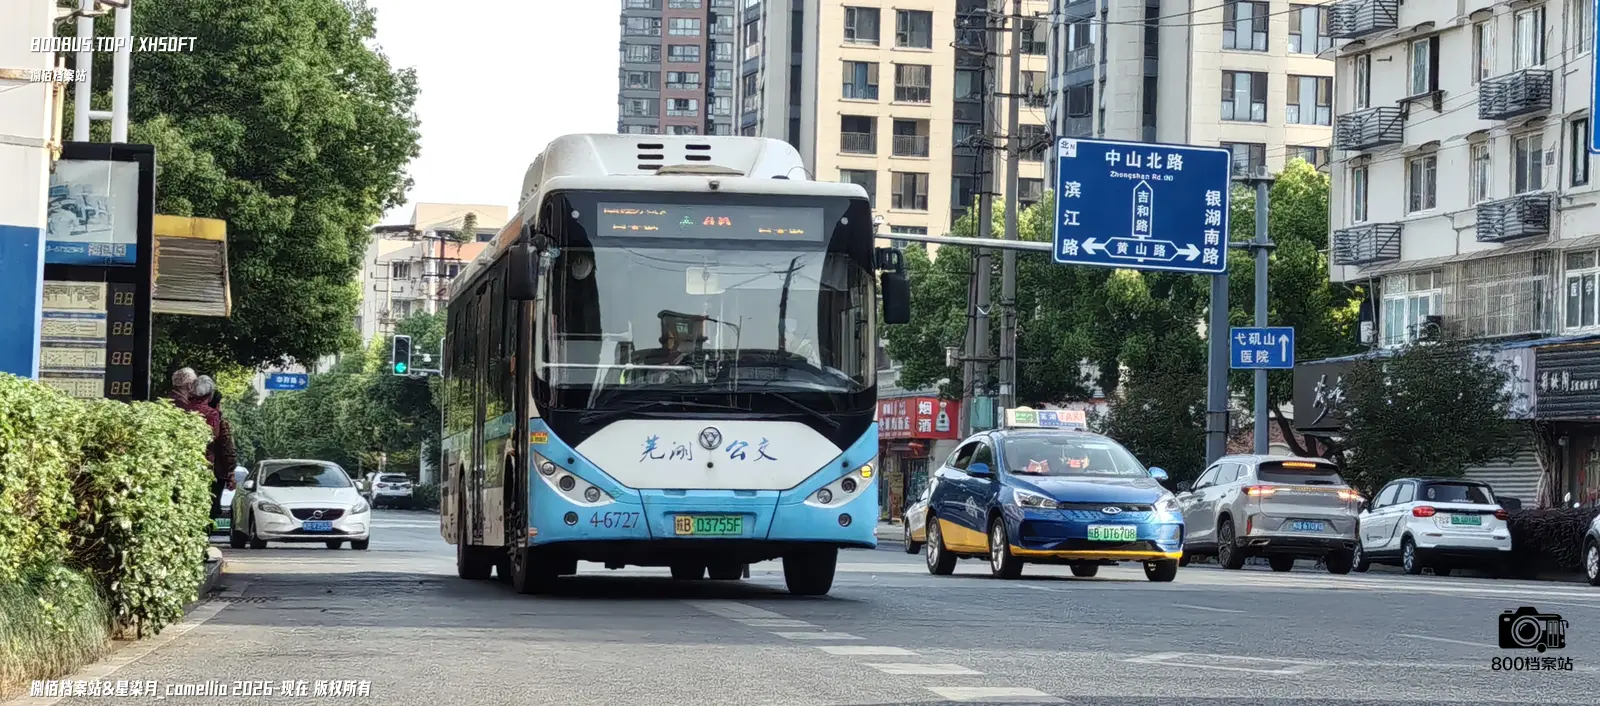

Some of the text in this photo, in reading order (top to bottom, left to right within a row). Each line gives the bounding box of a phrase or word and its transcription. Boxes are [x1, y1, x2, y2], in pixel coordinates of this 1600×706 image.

[1060, 140, 1070, 150] 北
[1105, 149, 1184, 171] 中山北路
[1110, 170, 1150, 180] Zhongshan
[1062, 181, 1081, 256] 滨江路
[1135, 190, 1150, 233] 吉和路
[1202, 189, 1221, 265] 银湖南路
[1116, 241, 1166, 257] 黄山路
[1234, 332, 1275, 346] 弋矶山
[1240, 350, 1270, 363] 医院
[919, 401, 932, 433] 烟酒
[1059, 411, 1084, 422] TAXI
[725, 437, 778, 462] 公交
[589, 512, 641, 529] 4-6727
